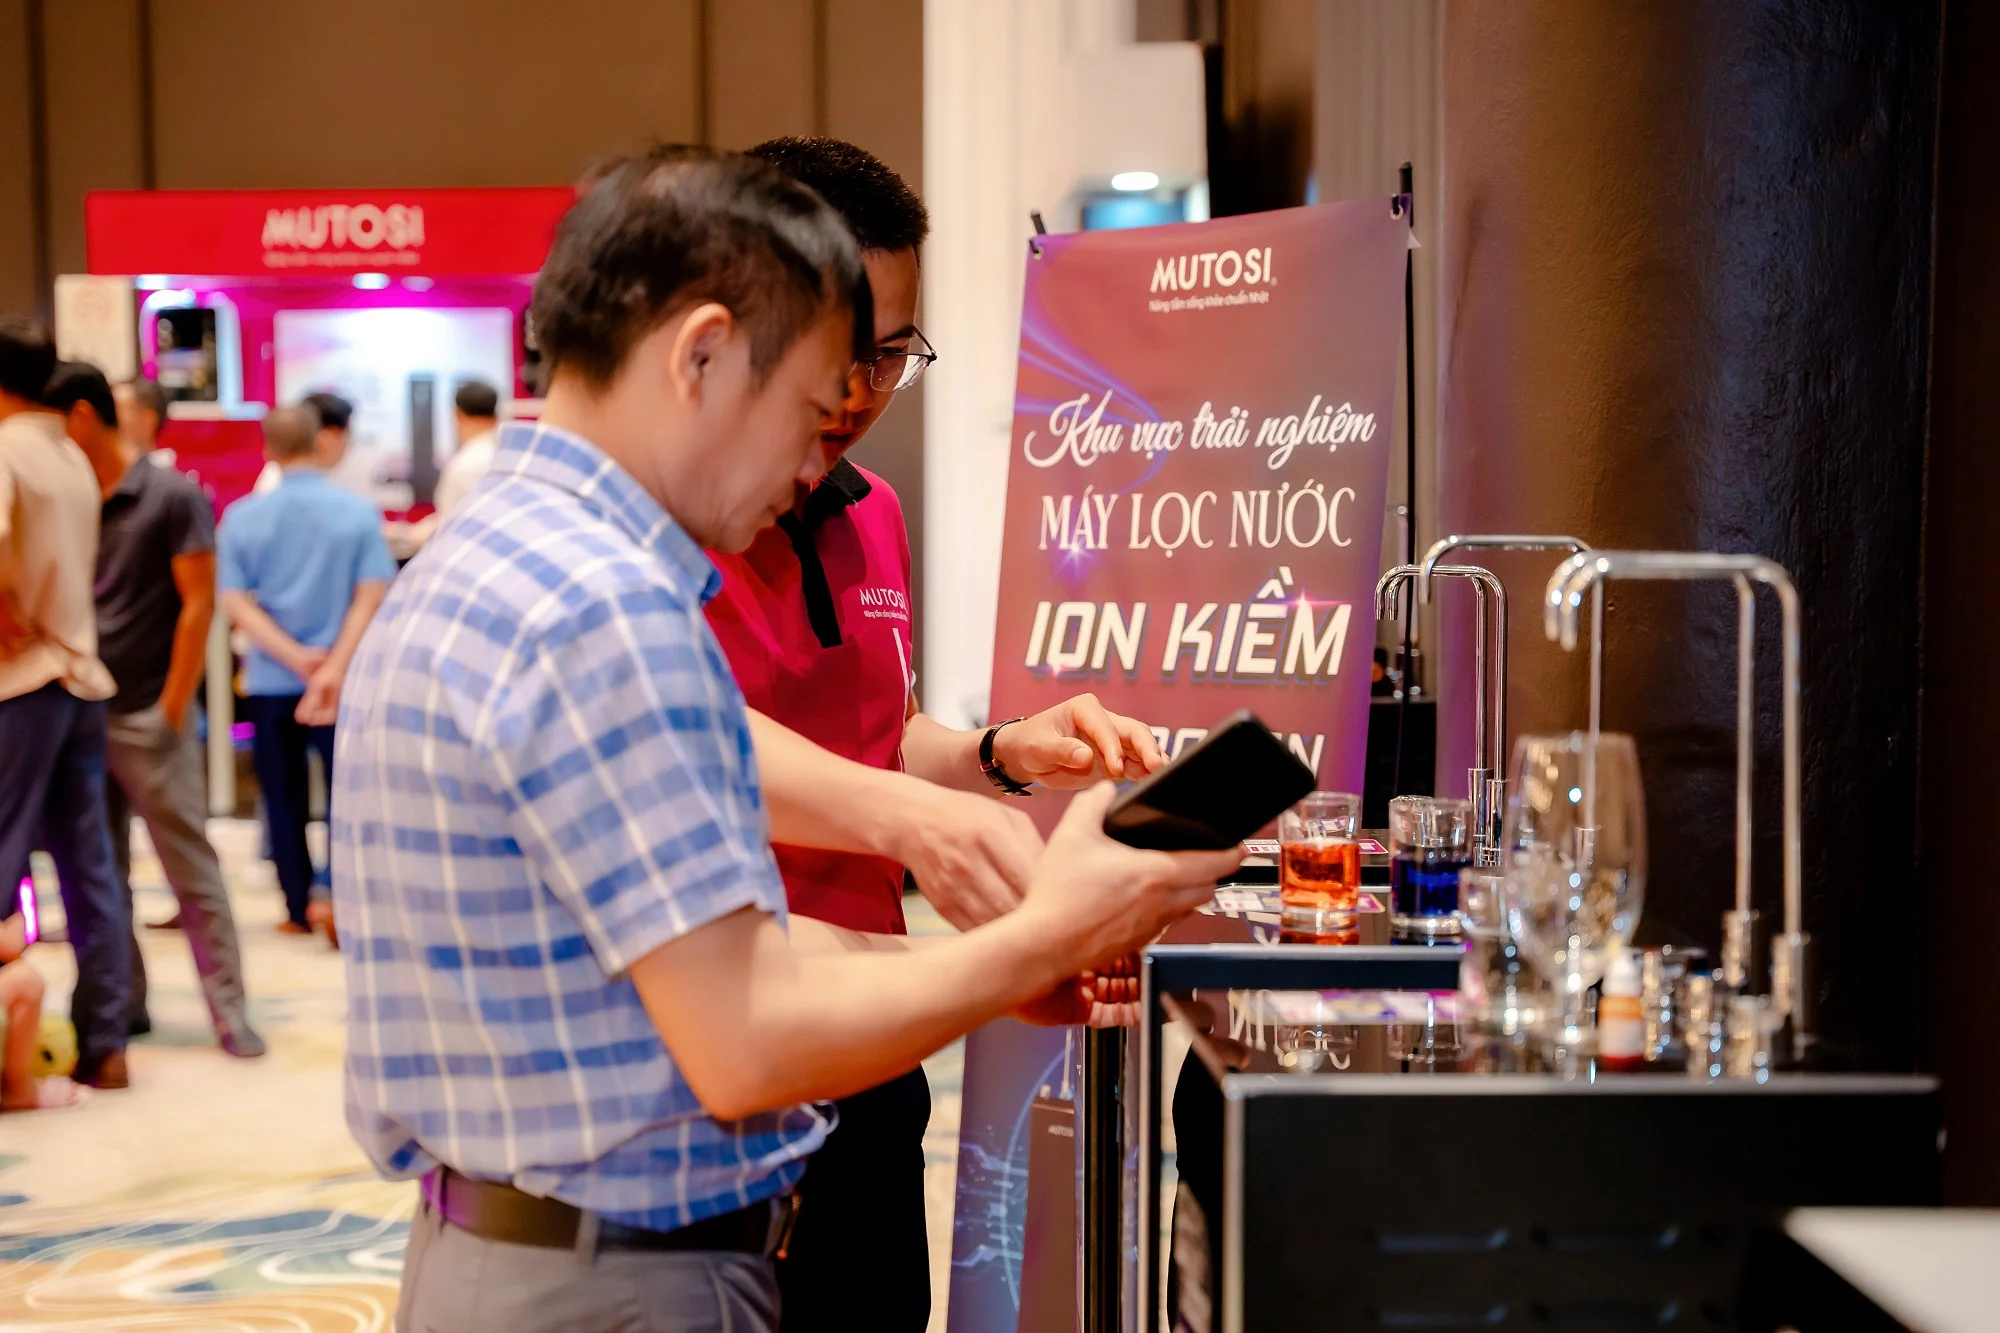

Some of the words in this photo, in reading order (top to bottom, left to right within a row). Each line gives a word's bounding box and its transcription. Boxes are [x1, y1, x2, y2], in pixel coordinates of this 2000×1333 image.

[261, 204, 425, 250] MUTOSI
[1149, 247, 1272, 293] MUTOSI
[1024, 389, 1124, 468] Khu
[1130, 420, 1184, 460] vực
[1190, 401, 1250, 450] trải
[1254, 394, 1377, 470] nghiệm
[1038, 484, 1120, 551] MÁY
[1128, 490, 1218, 559] LỌC
[1228, 478, 1356, 550] NƯỚC
[859, 587, 908, 615] MUTOSI
[1025, 600, 1147, 670] ION
[1161, 566, 1352, 676] KIỀM
